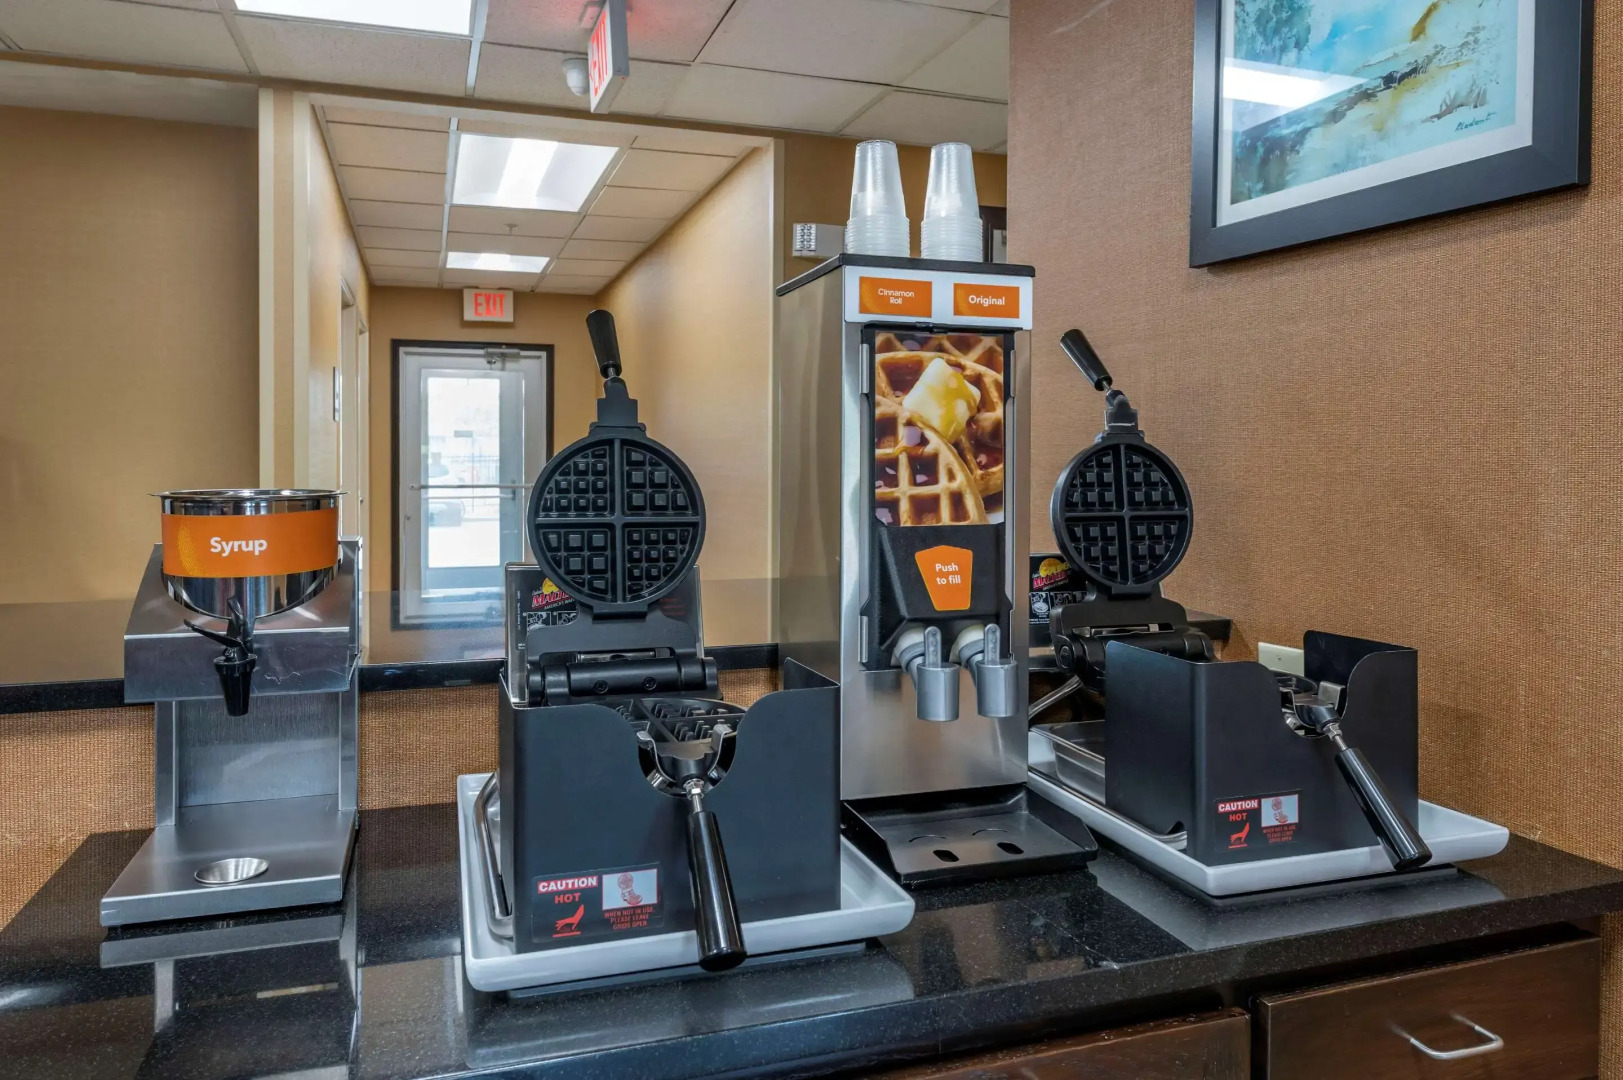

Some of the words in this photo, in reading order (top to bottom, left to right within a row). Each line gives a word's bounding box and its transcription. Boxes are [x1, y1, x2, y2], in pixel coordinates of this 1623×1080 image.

[590, 11, 608, 97] EXIT
[878, 288, 914, 298] Cinnamon
[474, 292, 505, 317] EXIT
[889, 297, 903, 305] Roll
[968, 295, 1006, 307] Original
[210, 536, 268, 557] Syrup
[935, 562, 959, 572] Push
[936, 576, 947, 585] to
[948, 574, 961, 584] fill
[1218, 799, 1258, 812] CAUTION
[1229, 812, 1247, 822] HOT
[538, 876, 597, 892] CAUTION
[554, 892, 581, 904] HOT
[604, 910, 621, 918] WHEN
[632, 913, 649, 921] LEAVE
[613, 922, 630, 930] GRIDS
[632, 920, 647, 928] OPEN
